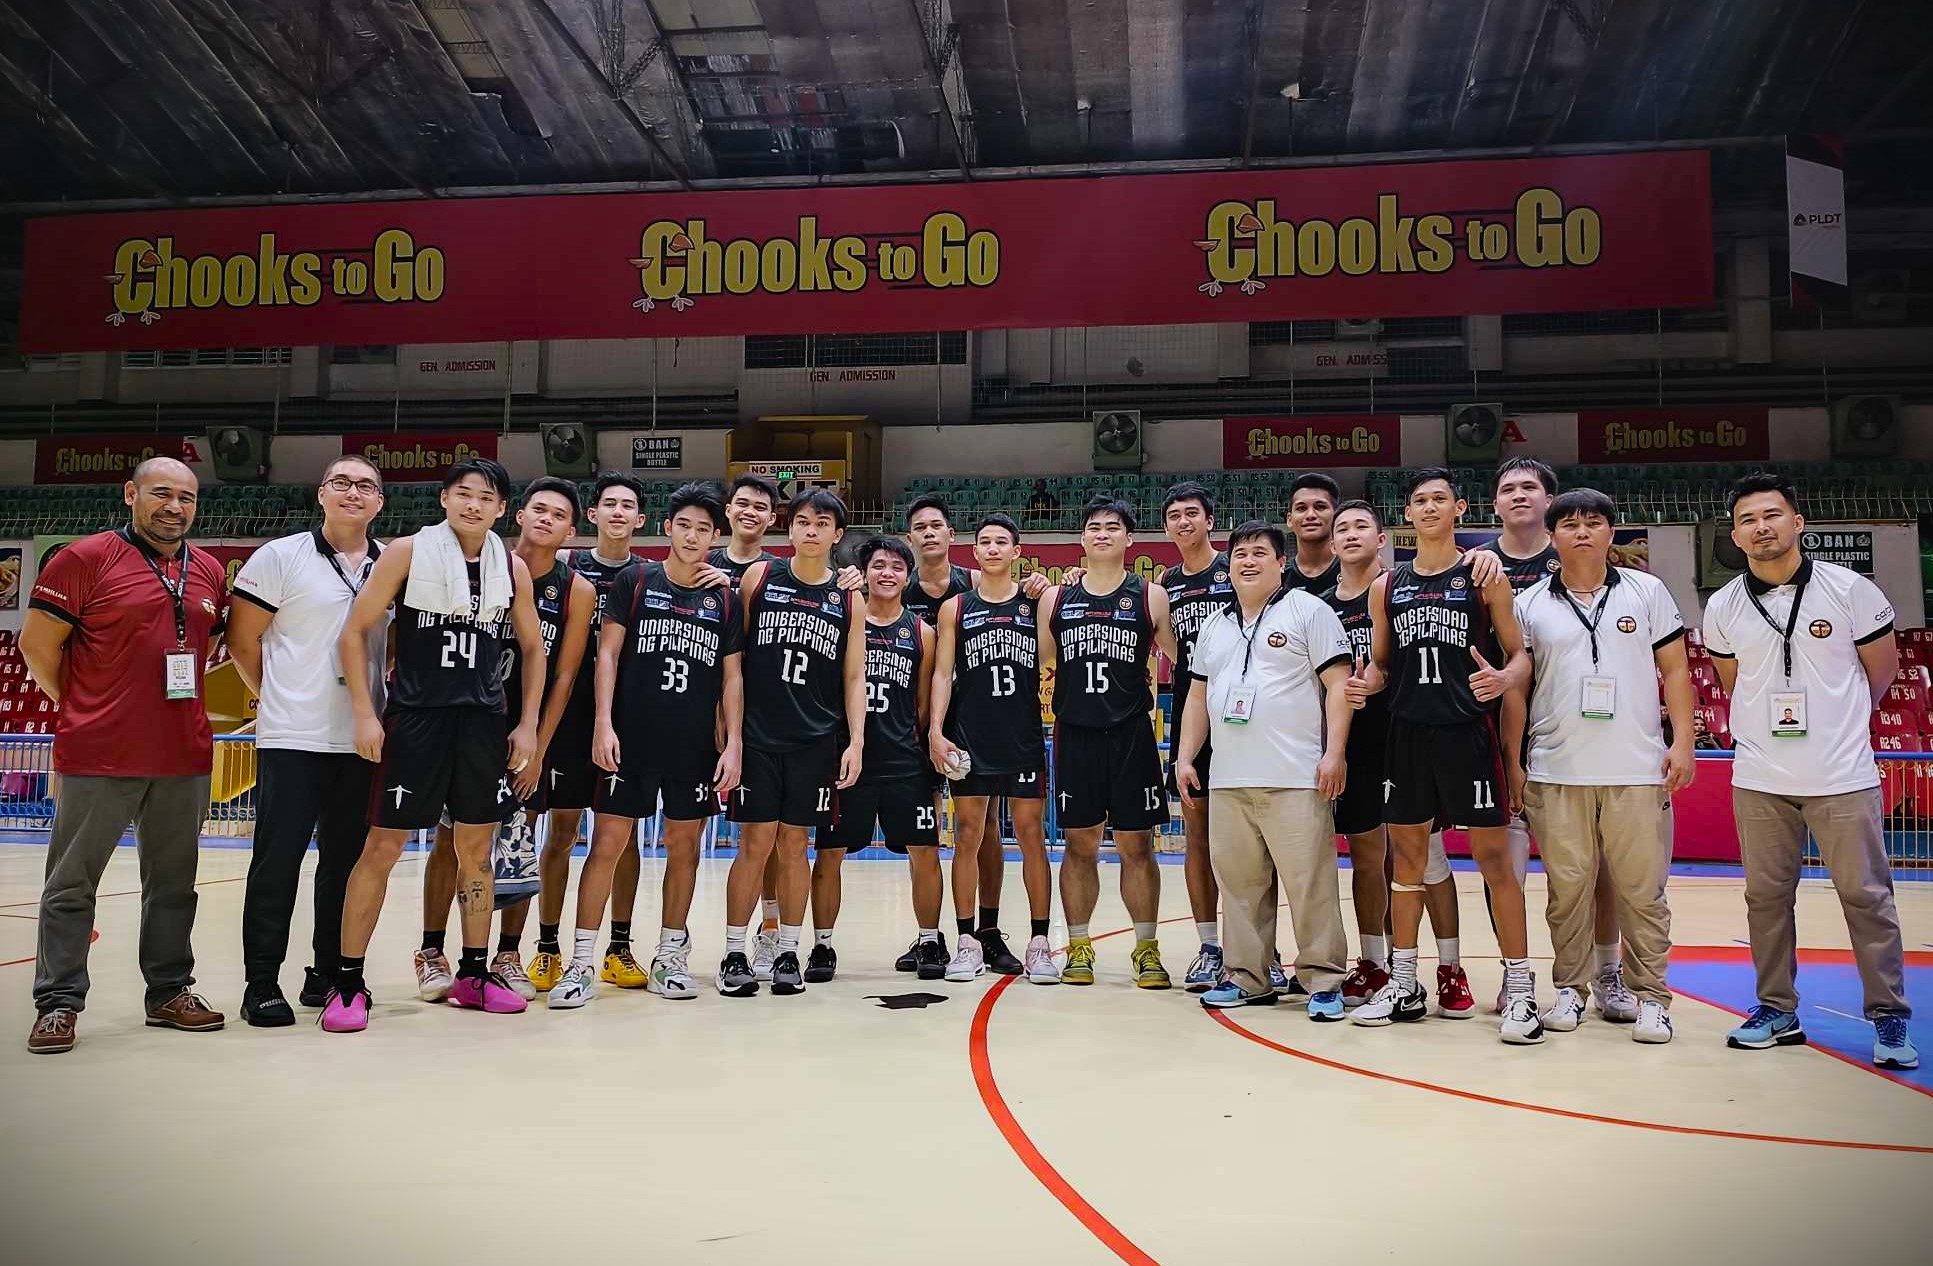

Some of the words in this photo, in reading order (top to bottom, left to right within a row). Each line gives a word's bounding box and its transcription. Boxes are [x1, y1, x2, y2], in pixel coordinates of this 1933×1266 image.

[1809, 213, 1841, 224] PLDT
[1207, 195, 1454, 283] Chooks
[1466, 220, 1508, 260] to
[1516, 188, 1600, 268] Go
[642, 216, 867, 300] Chooks
[878, 242, 915, 280] to
[923, 212, 999, 288] Go
[113, 233, 321, 314] Chooks
[332, 258, 367, 295] to
[374, 230, 444, 303] Go
[445, 360, 496, 372] ADMISSION
[840, 370, 896, 382] ADMISSION
[648, 439, 669, 449] BAN
[1248, 428, 1332, 456] Chooks
[1335, 437, 1350, 450] to
[1352, 427, 1380, 452] Go
[1604, 421, 1695, 450] Chooks
[1716, 420, 1747, 447] Go
[55, 447, 124, 473] Chooks
[364, 443, 438, 469] Chooks
[751, 465, 767, 474] NO
[778, 471, 795, 479] EXIT
[1823, 534, 1854, 548] BAN
[1835, 551, 1870, 560] PLASTIC
[638, 618, 719, 651] UNIBERSIDAD
[758, 611, 841, 645] UNIBERSIDAD
[964, 628, 1036, 656] UNIBERSIDAD
[1060, 623, 1138, 647] UNIBERSIDAD
[441, 630, 477, 669] 24
[637, 636, 657, 654] NG
[659, 635, 716, 667] PILIPINAS
[757, 627, 774, 646] NG
[777, 627, 837, 661] PILIPINAS
[982, 643, 1035, 669] PILIPINAS
[1078, 639, 1135, 663] PILIPINAS
[661, 657, 689, 694] 33
[781, 648, 809, 686] 12
[1085, 661, 1110, 694] 15
[1418, 646, 1442, 685] 11
[990, 664, 1016, 697] 13
[816, 787, 831, 812] 12
[1144, 785, 1161, 811] 15
[1473, 780, 1495, 809] 11
[916, 806, 935, 830] 25
